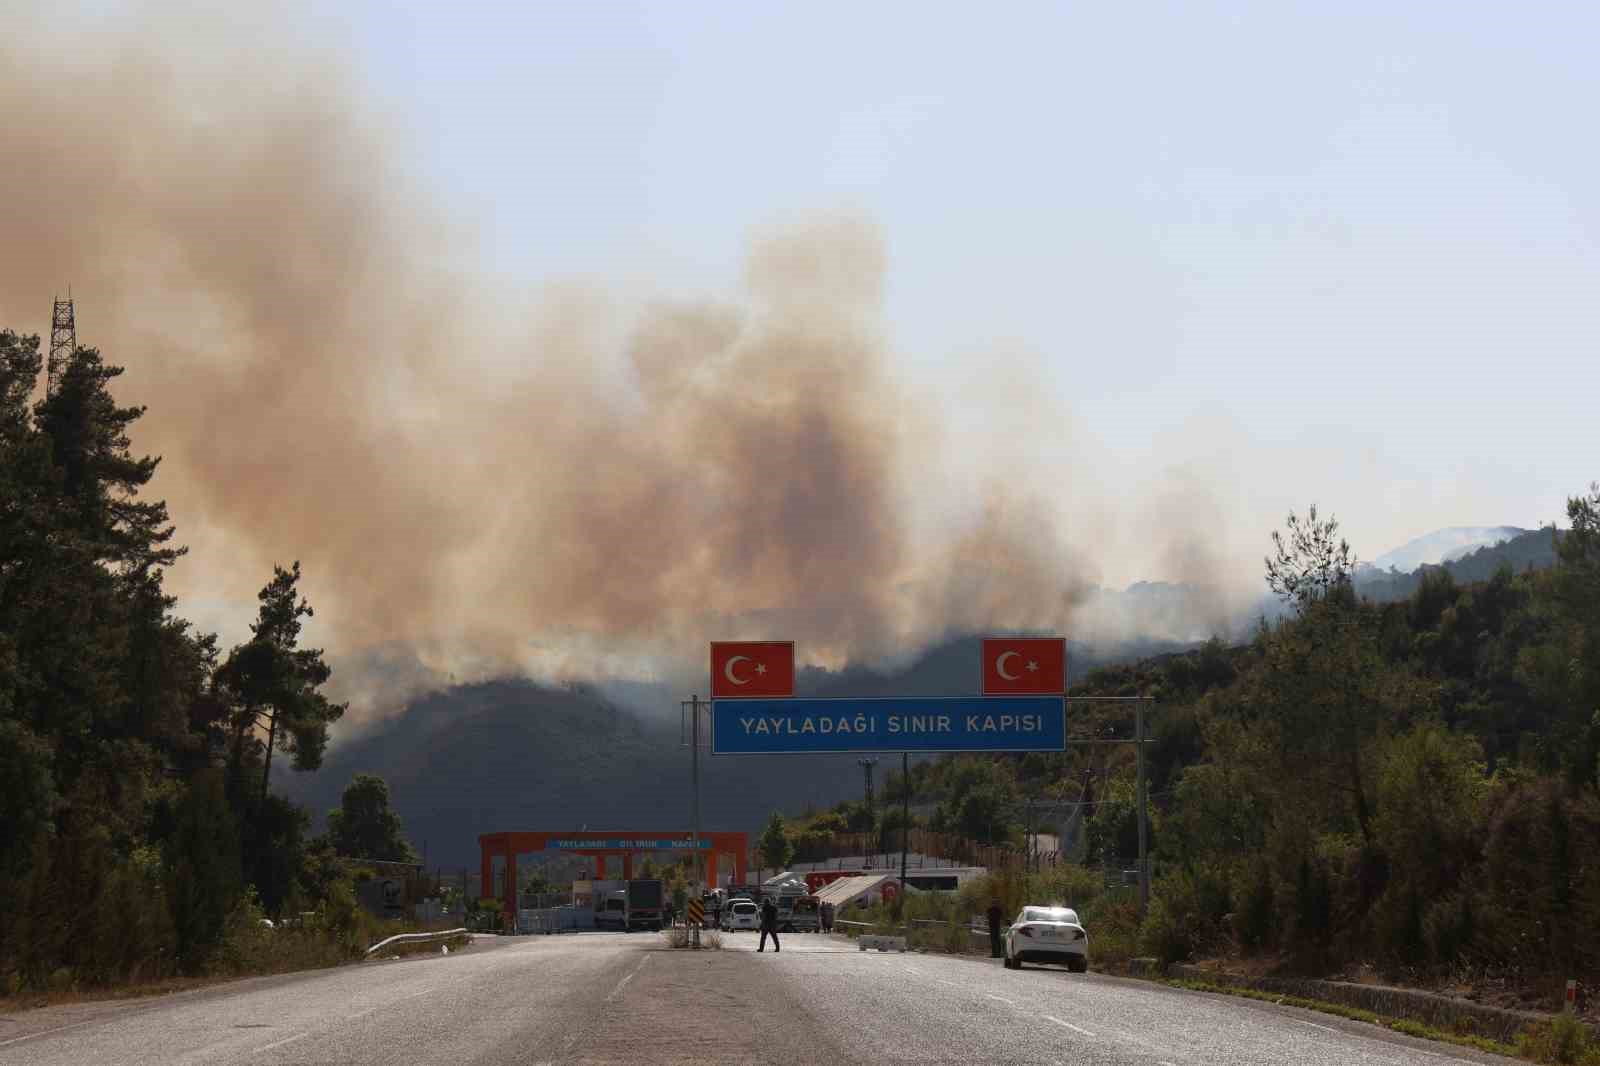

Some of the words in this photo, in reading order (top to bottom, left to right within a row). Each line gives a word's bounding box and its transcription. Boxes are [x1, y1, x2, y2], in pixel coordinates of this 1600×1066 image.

[739, 712, 876, 734] YAYLADAĞI
[887, 714, 952, 733] SINIR
[966, 713, 1043, 732] KAPISI
